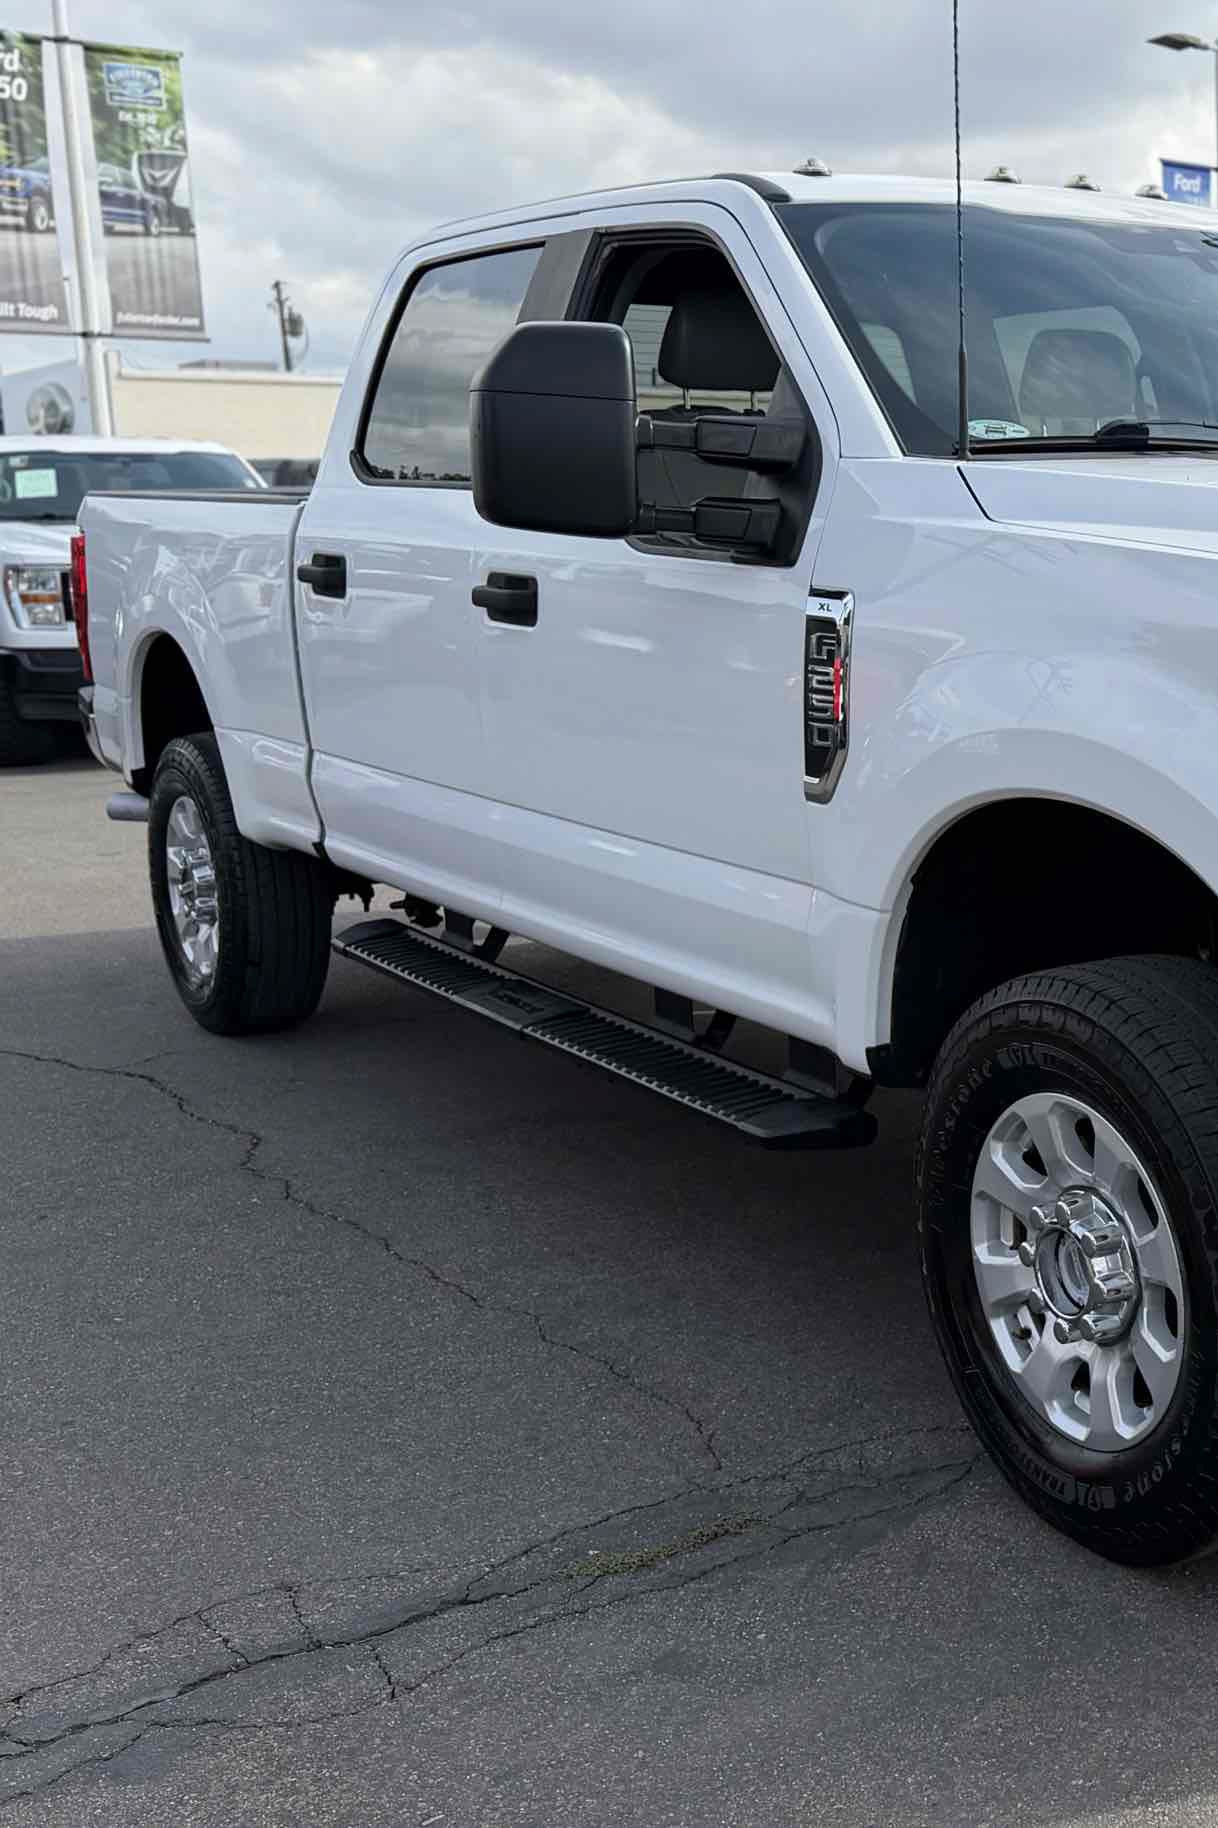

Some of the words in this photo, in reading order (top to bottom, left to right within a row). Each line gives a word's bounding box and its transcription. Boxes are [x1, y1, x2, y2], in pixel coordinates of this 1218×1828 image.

[1173, 171, 1202, 194] Ford
[17, 303, 59, 320] Tough
[817, 602, 833, 612] XL
